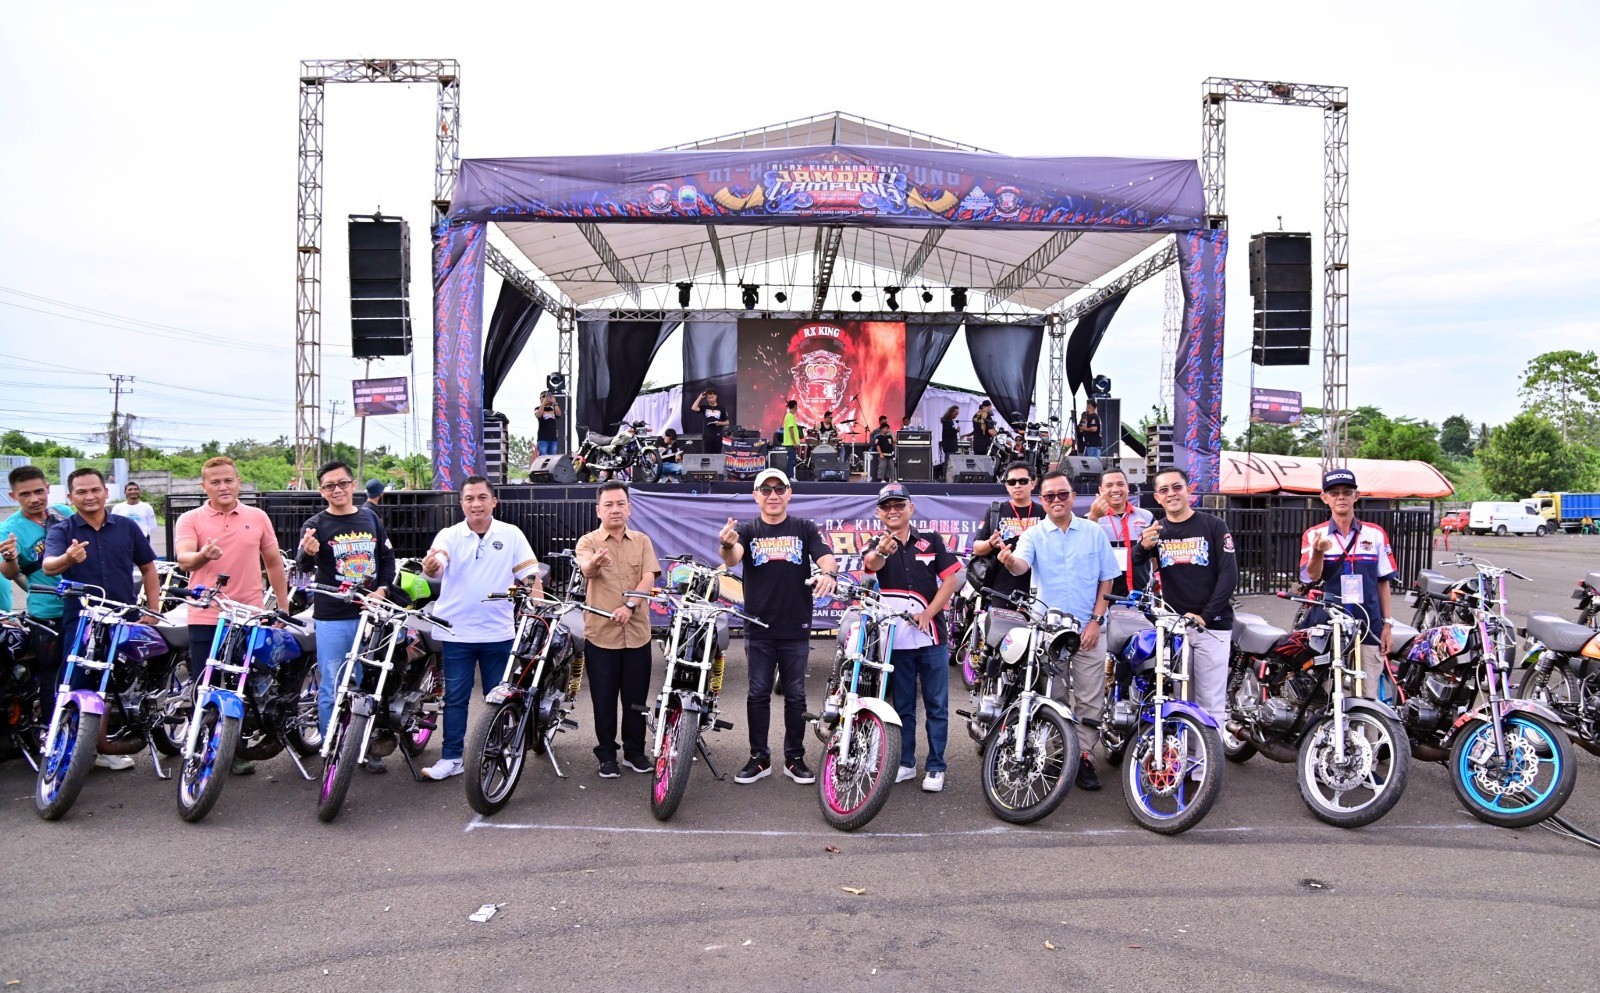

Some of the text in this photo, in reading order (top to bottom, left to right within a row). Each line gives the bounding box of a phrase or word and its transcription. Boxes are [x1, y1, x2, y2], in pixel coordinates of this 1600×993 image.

[776, 171, 874, 183] JAMDA
[768, 181, 903, 206] LAMPUNG
[804, 326, 841, 338] RX KING
[855, 519, 888, 531] KIN
